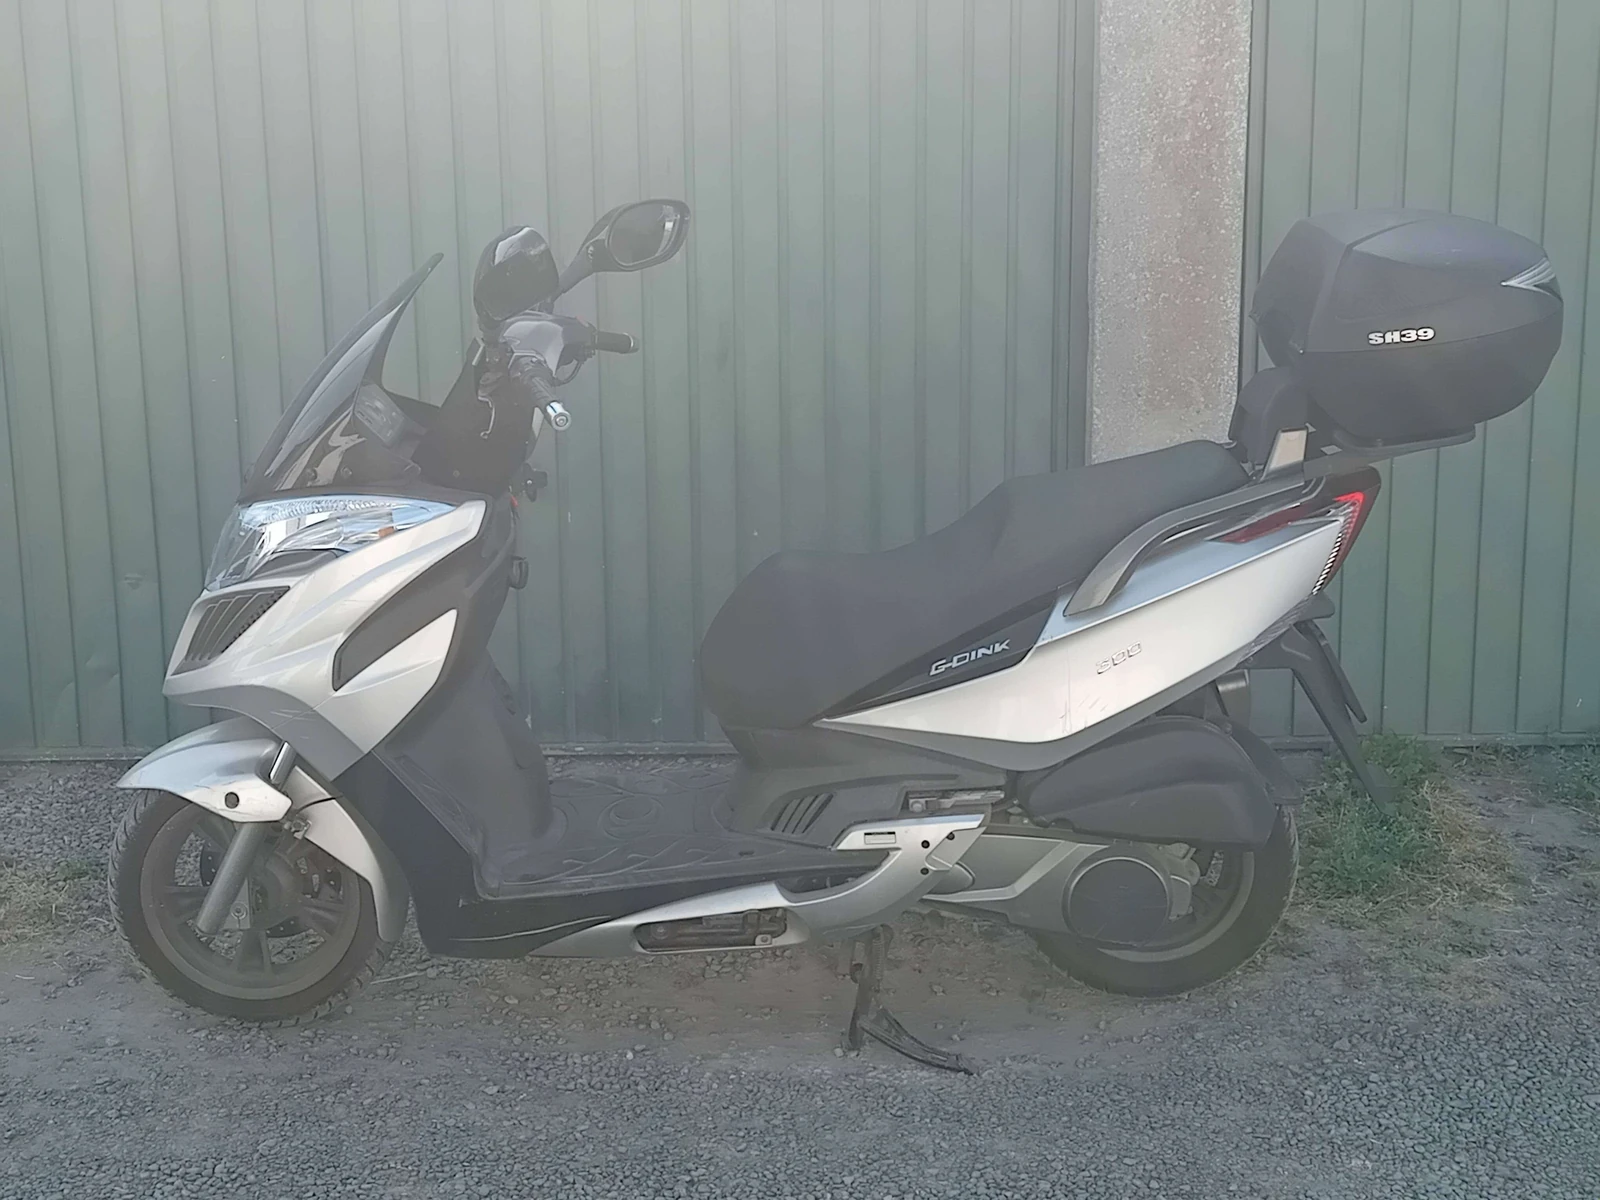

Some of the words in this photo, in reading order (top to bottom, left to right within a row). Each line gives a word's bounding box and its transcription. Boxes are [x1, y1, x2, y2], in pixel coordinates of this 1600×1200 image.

[1367, 326, 1436, 346] SH39
[929, 639, 1010, 676] G-DINK
[1095, 640, 1142, 675] 300
